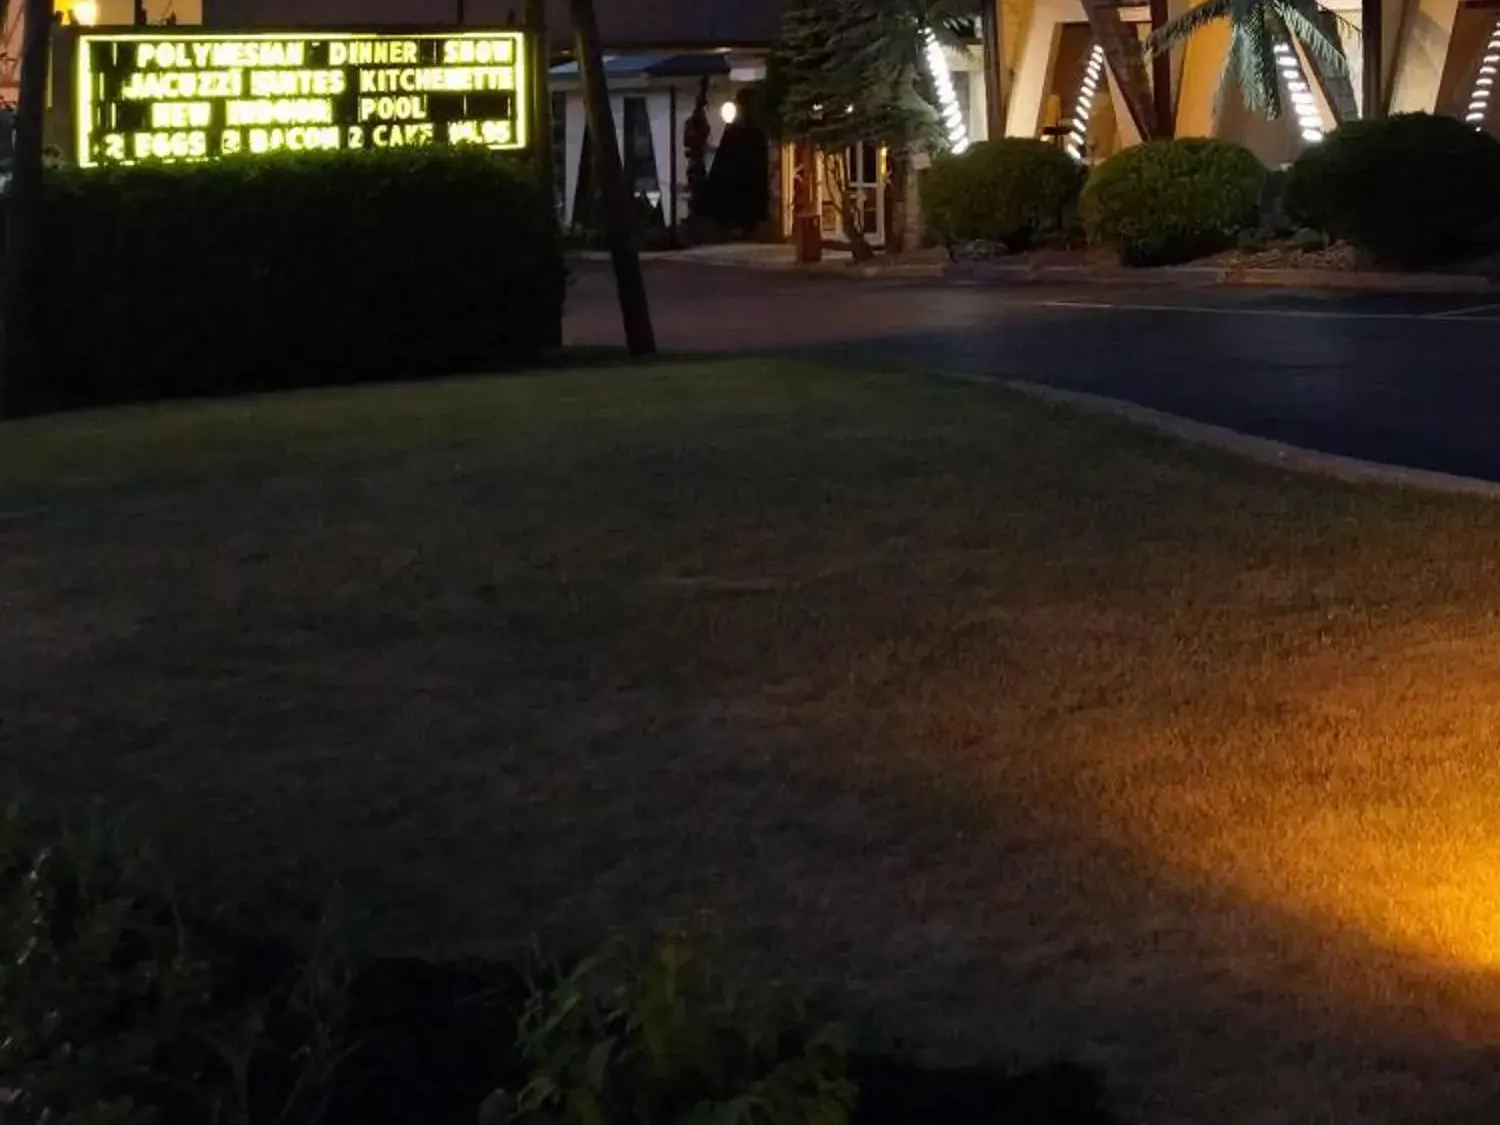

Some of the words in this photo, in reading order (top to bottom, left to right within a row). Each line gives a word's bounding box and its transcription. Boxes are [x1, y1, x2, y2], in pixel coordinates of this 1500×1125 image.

[137, 42, 304, 67] POLYNESIAN
[329, 41, 417, 65] DINNER
[443, 40, 513, 63] SHOW
[122, 69, 242, 98] JACUZZI
[152, 101, 211, 128] NEW
[360, 96, 426, 120] POOL
[105, 133, 125, 160] 2
[134, 131, 206, 158] EGGS
[249, 125, 339, 154] BACON
[348, 126, 363, 148] 2
